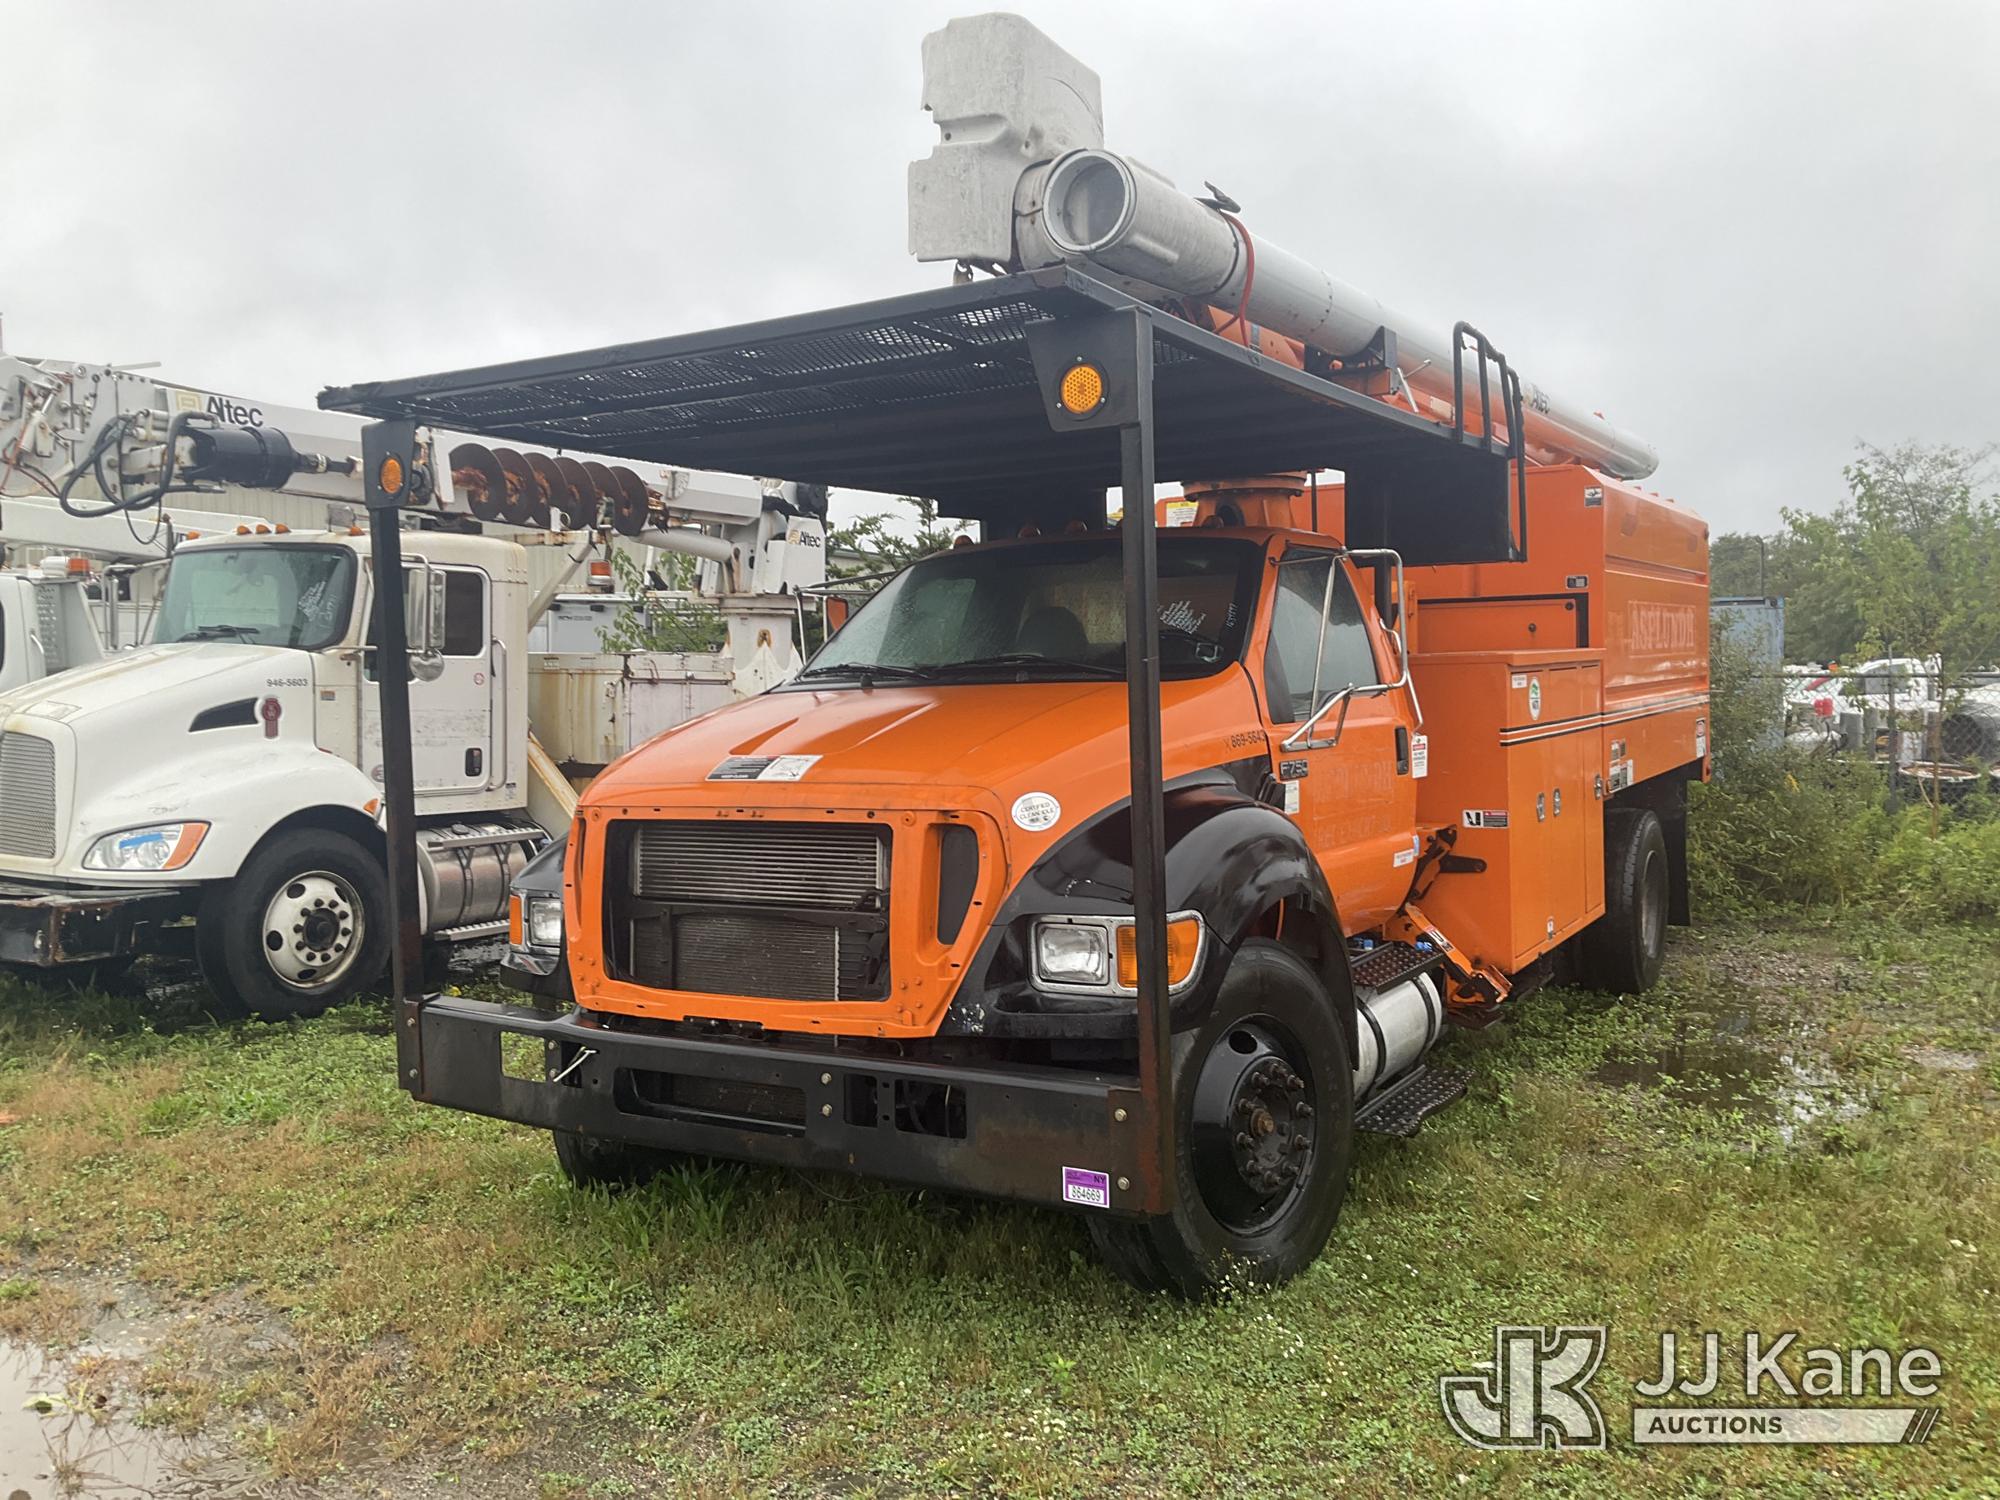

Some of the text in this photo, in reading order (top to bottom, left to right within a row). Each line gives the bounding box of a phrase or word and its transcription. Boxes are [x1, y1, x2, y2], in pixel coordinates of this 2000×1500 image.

[207, 396, 264, 427] Altec
[800, 531, 821, 547] Altec
[1094, 1175, 1106, 1184] NY
